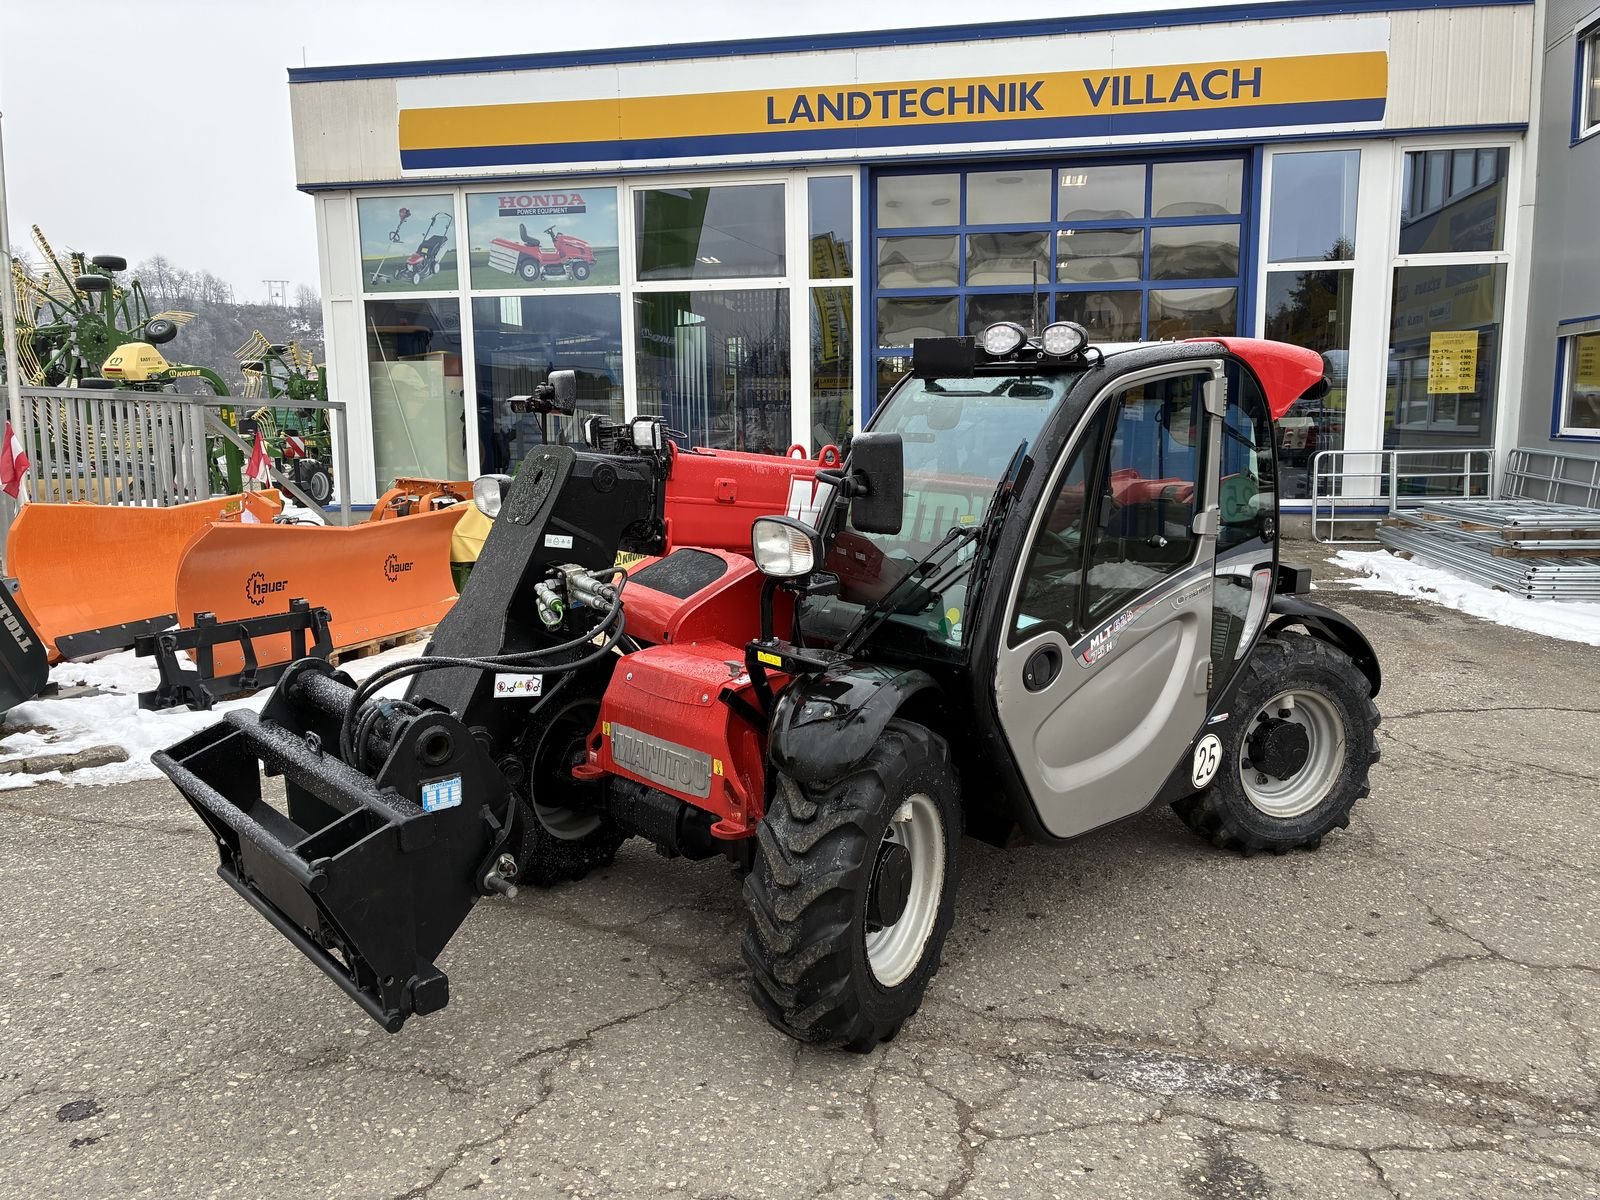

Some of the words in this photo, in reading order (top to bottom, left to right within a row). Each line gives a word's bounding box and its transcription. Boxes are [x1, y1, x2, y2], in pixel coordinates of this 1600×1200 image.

[767, 80, 1045, 125] LANDTECHNIK
[1082, 67, 1262, 107] VILLACH
[498, 193, 586, 208] HONDA
[537, 207, 568, 215] EQUIPMENT
[176, 369, 201, 377] KRONE
[389, 561, 414, 573] hauer
[253, 580, 288, 595] hauer
[1090, 624, 1112, 651] MLT
[1106, 641, 1113, 653] H
[613, 731, 709, 790] MANITOU
[1196, 743, 1217, 781] 25
